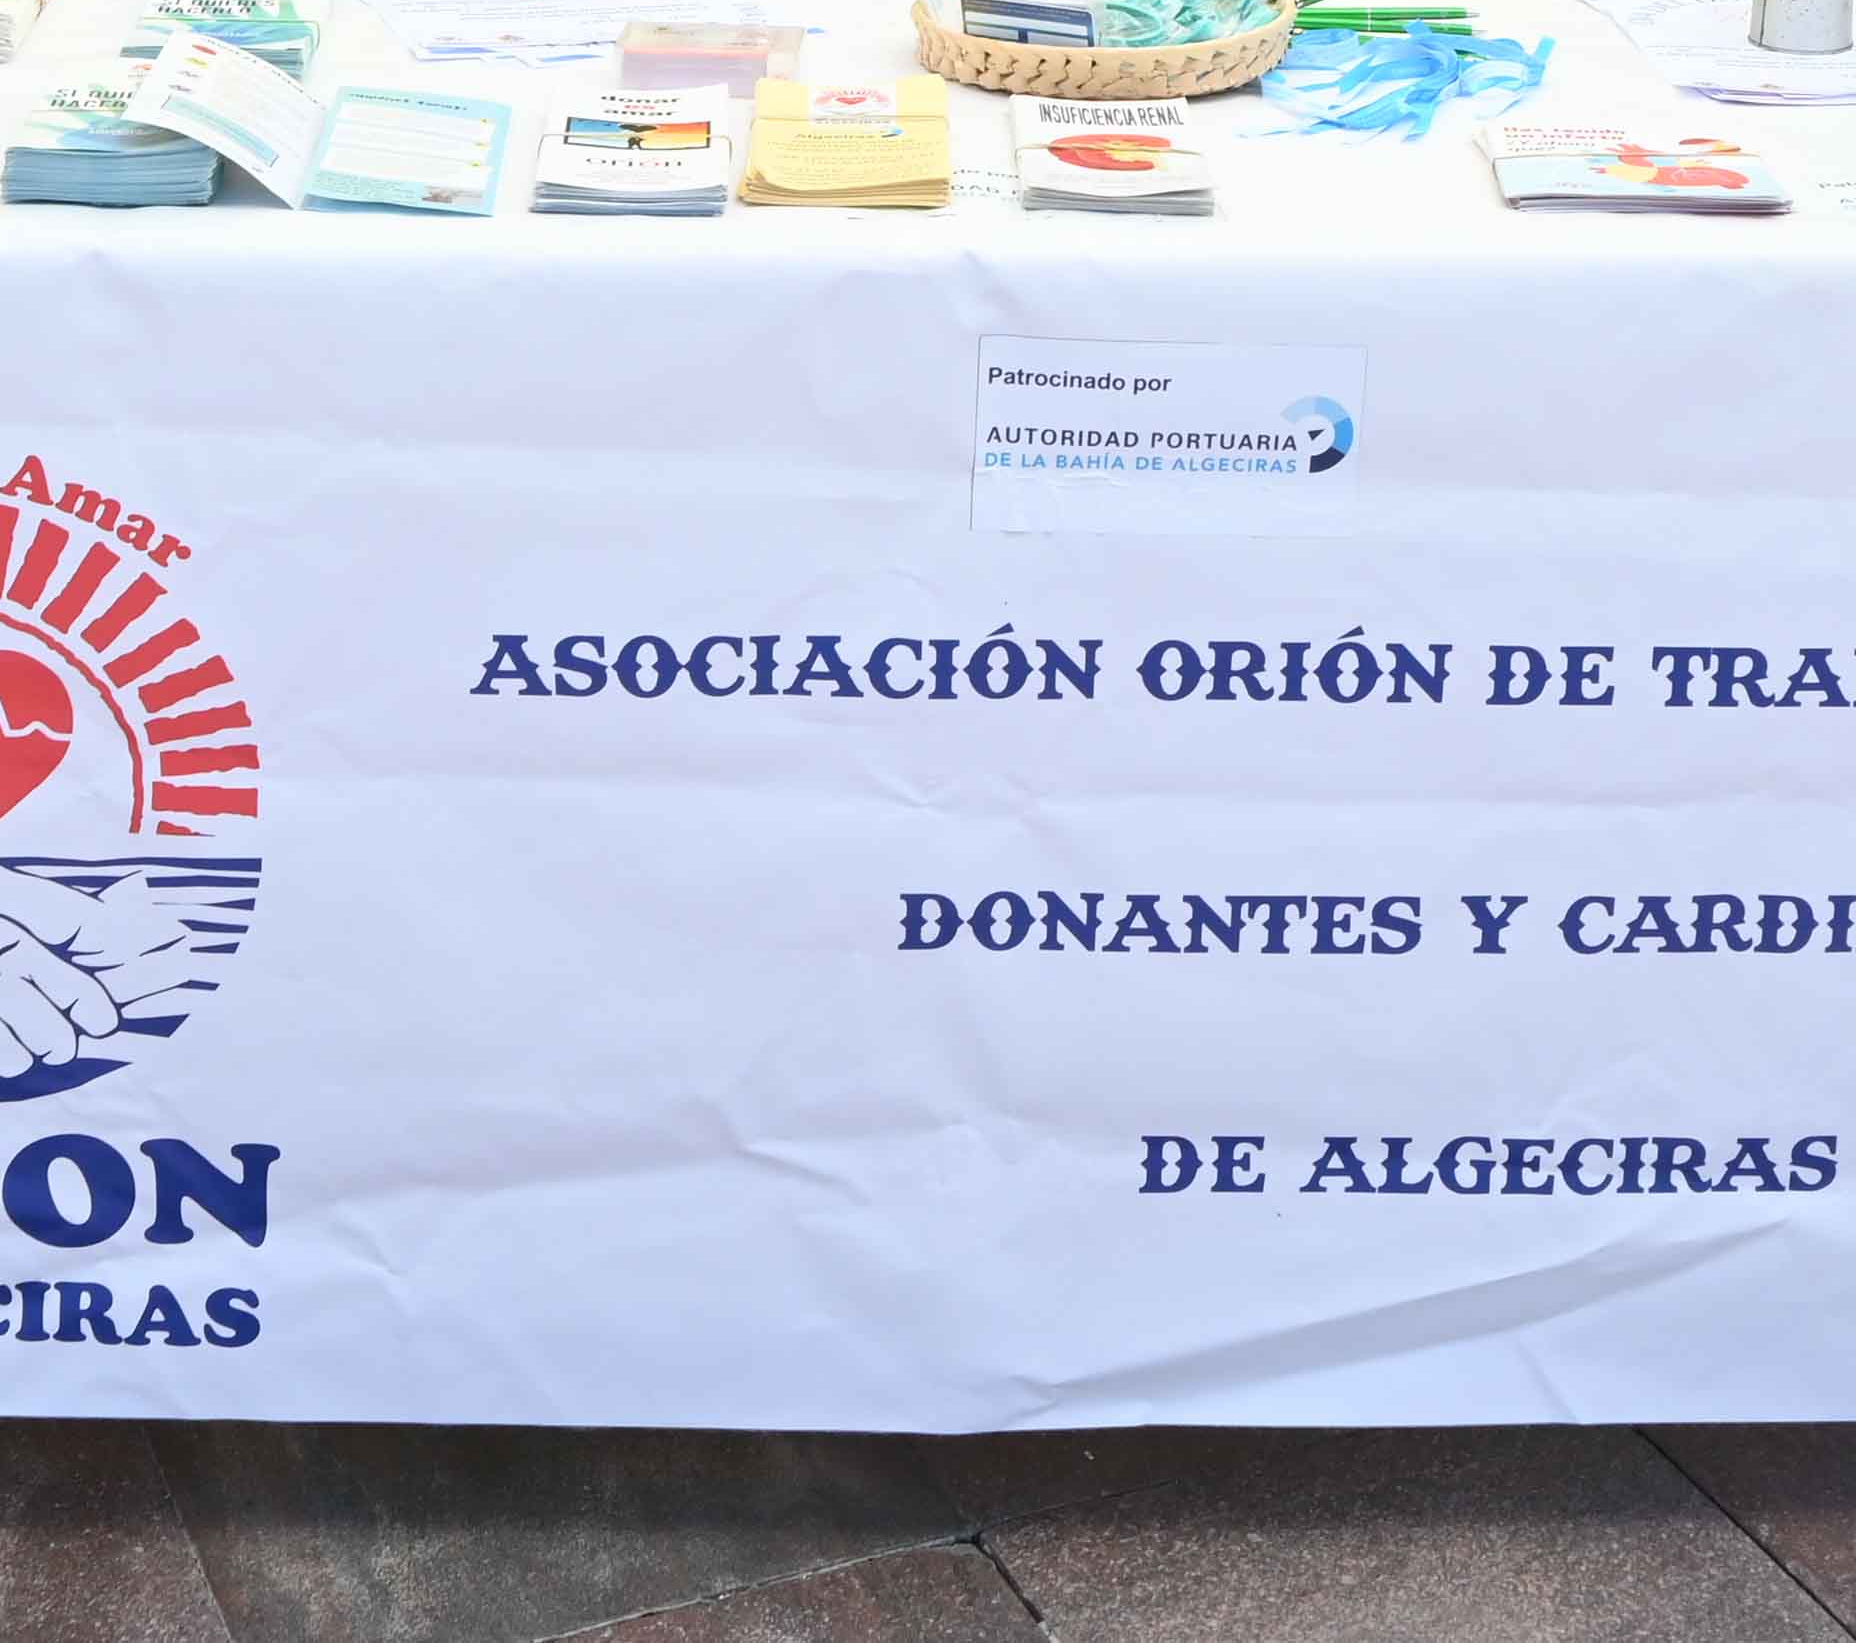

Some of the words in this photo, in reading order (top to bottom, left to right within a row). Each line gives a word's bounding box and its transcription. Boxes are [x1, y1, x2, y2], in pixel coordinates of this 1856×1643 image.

[1038, 103, 1138, 127] INSUFICIENCIA
[1139, 105, 1185, 127] RENAL
[987, 366, 1126, 391] Patrocinado
[1133, 375, 1172, 395] por
[986, 425, 1139, 449] AUTORIDAD
[1150, 431, 1298, 452] PORTUARIA
[984, 451, 1011, 468] DE
[1020, 452, 1046, 468] LA
[1056, 451, 1126, 471] BAHÍA
[1136, 455, 1163, 471] DE
[1172, 456, 1298, 474] ALGECIRAS
[0, 455, 192, 568] Amar
[470, 622, 1104, 700] ASOCIACIÓN
[1136, 624, 1453, 705] ORIÓN
[1487, 644, 1615, 707] DE
[897, 888, 1424, 956] DONANTES
[1462, 894, 1529, 955] Y
[1138, 1134, 1267, 1195] DE
[1299, 1133, 1840, 1196] ALGECIRAS
